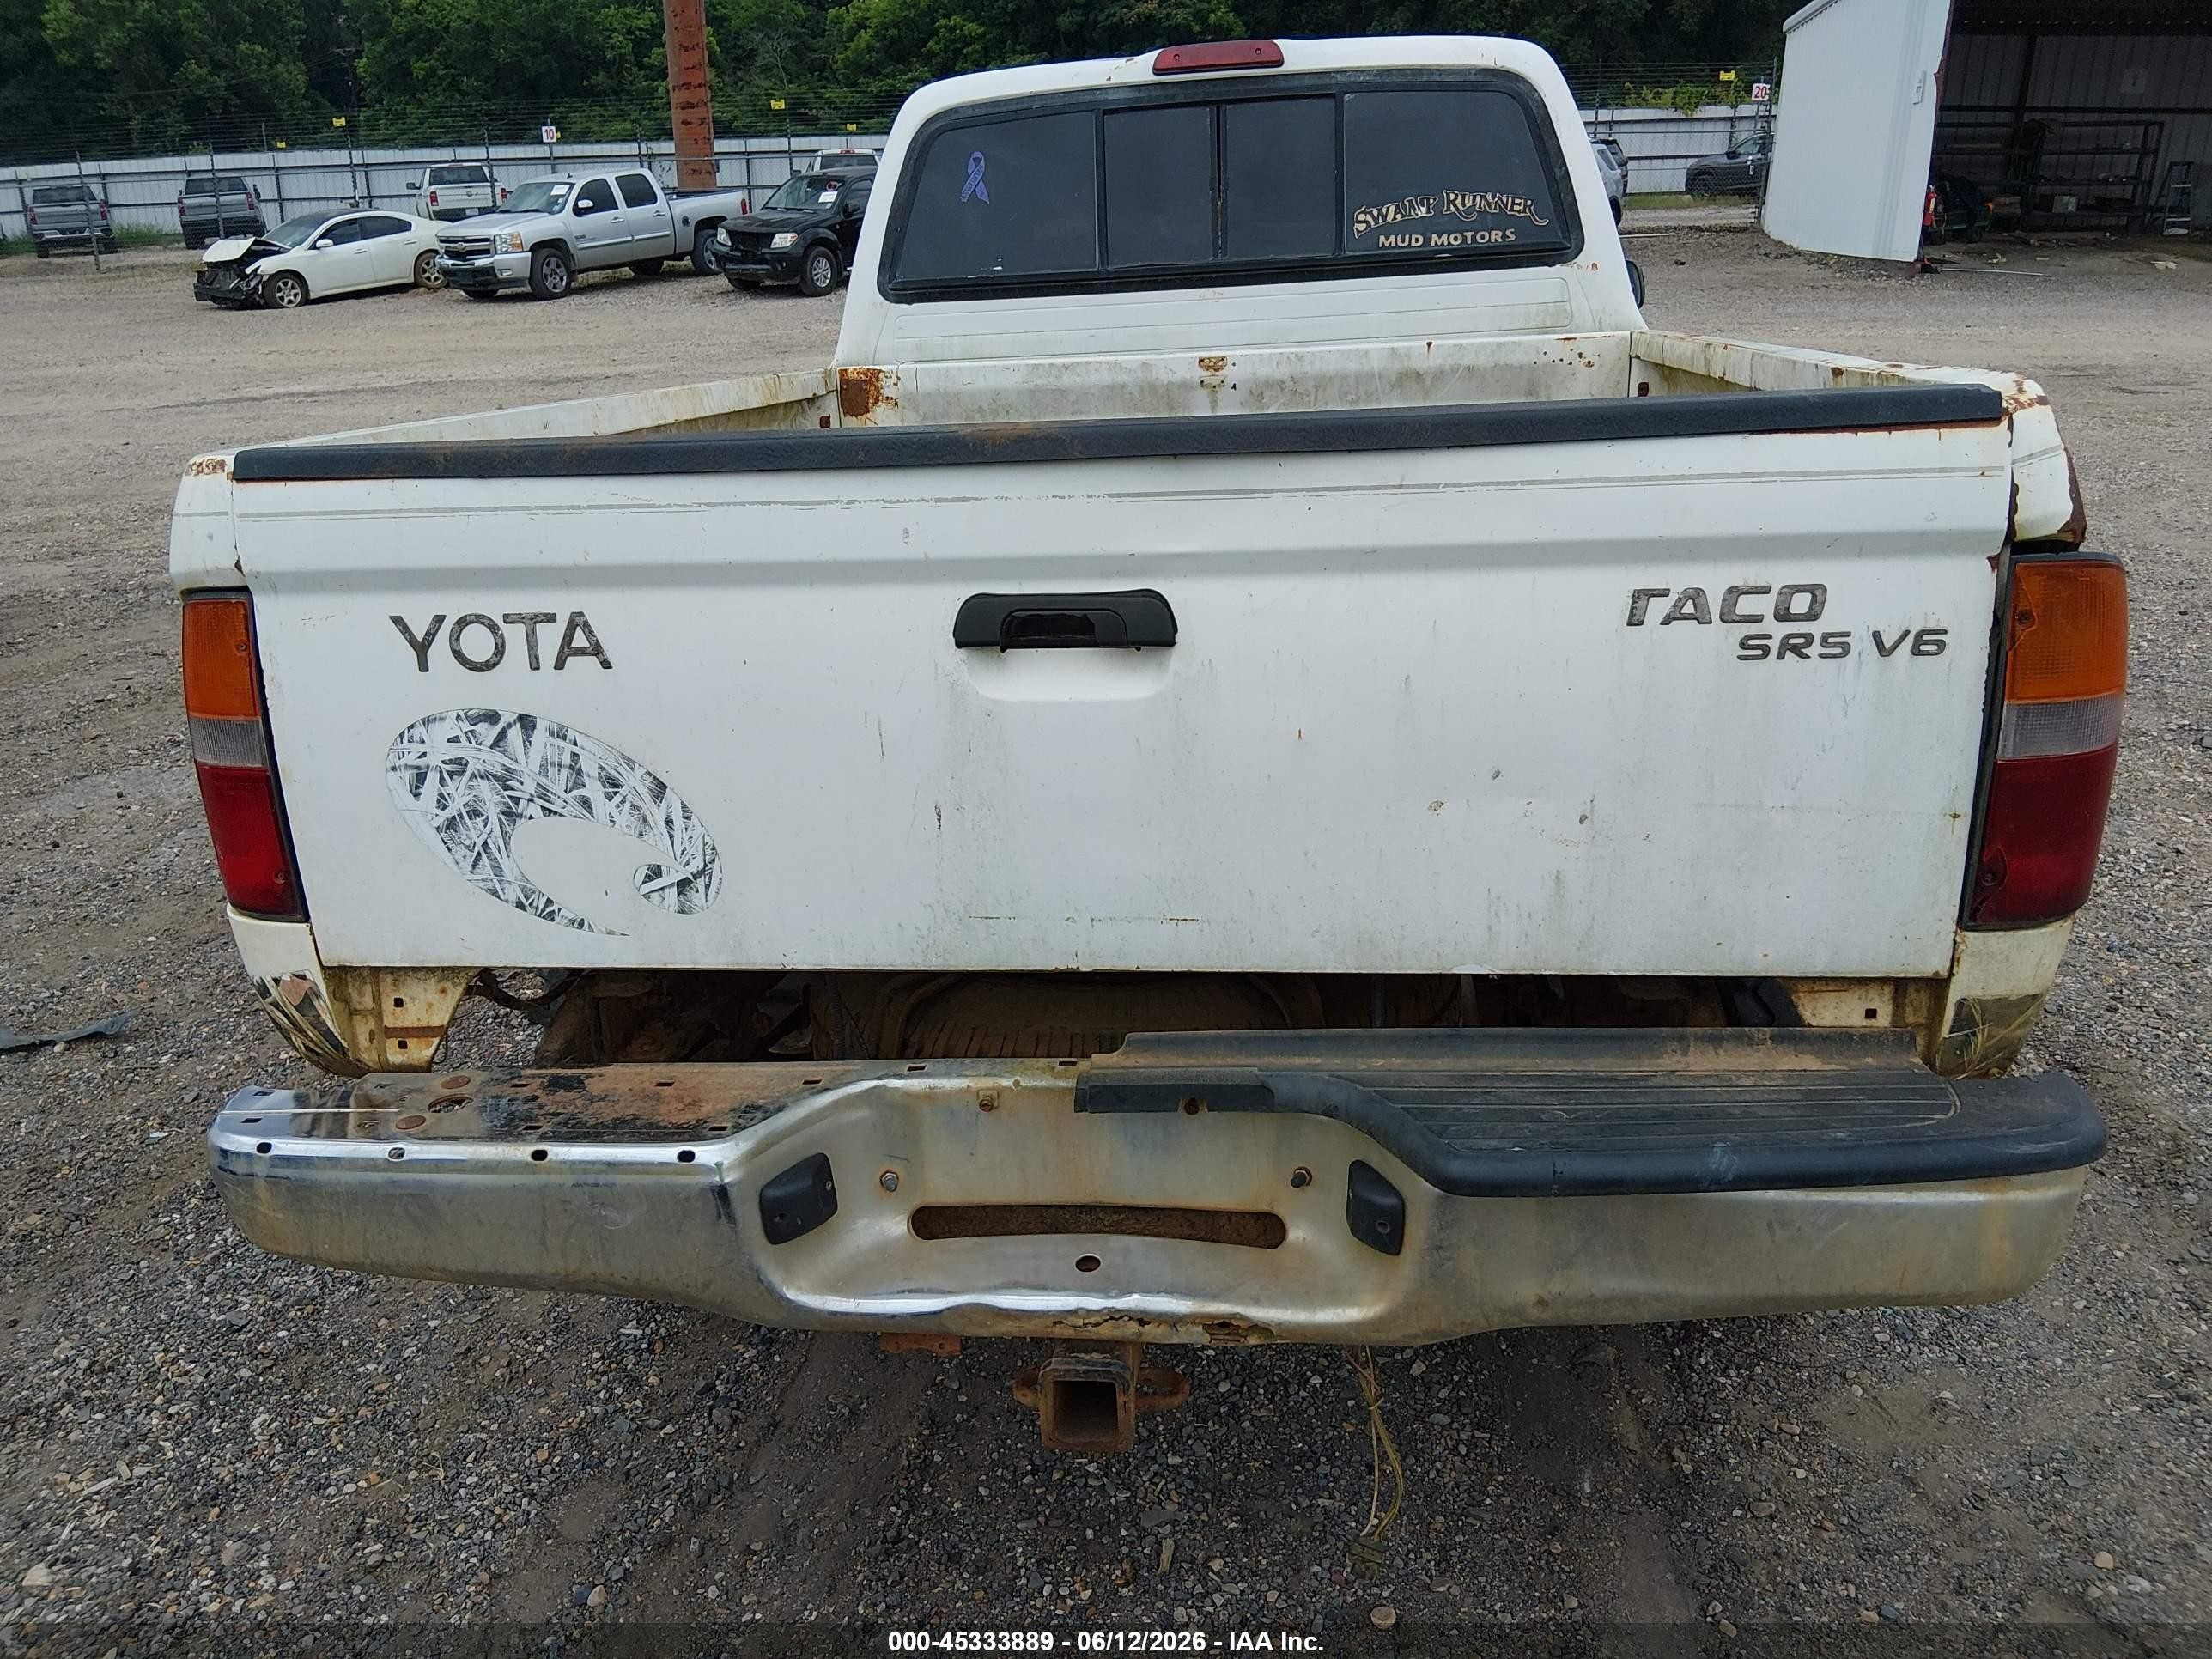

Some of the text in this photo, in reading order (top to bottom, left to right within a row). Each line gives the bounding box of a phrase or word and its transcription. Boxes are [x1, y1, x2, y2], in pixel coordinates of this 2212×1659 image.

[1754, 86, 1767, 99] 20
[544, 129, 555, 140] 10
[1443, 189, 1549, 226] RUNNER
[1379, 228, 1517, 248] MUD MOTORS
[389, 611, 613, 673] YOTA
[1737, 629, 1948, 661] SR5 V6
